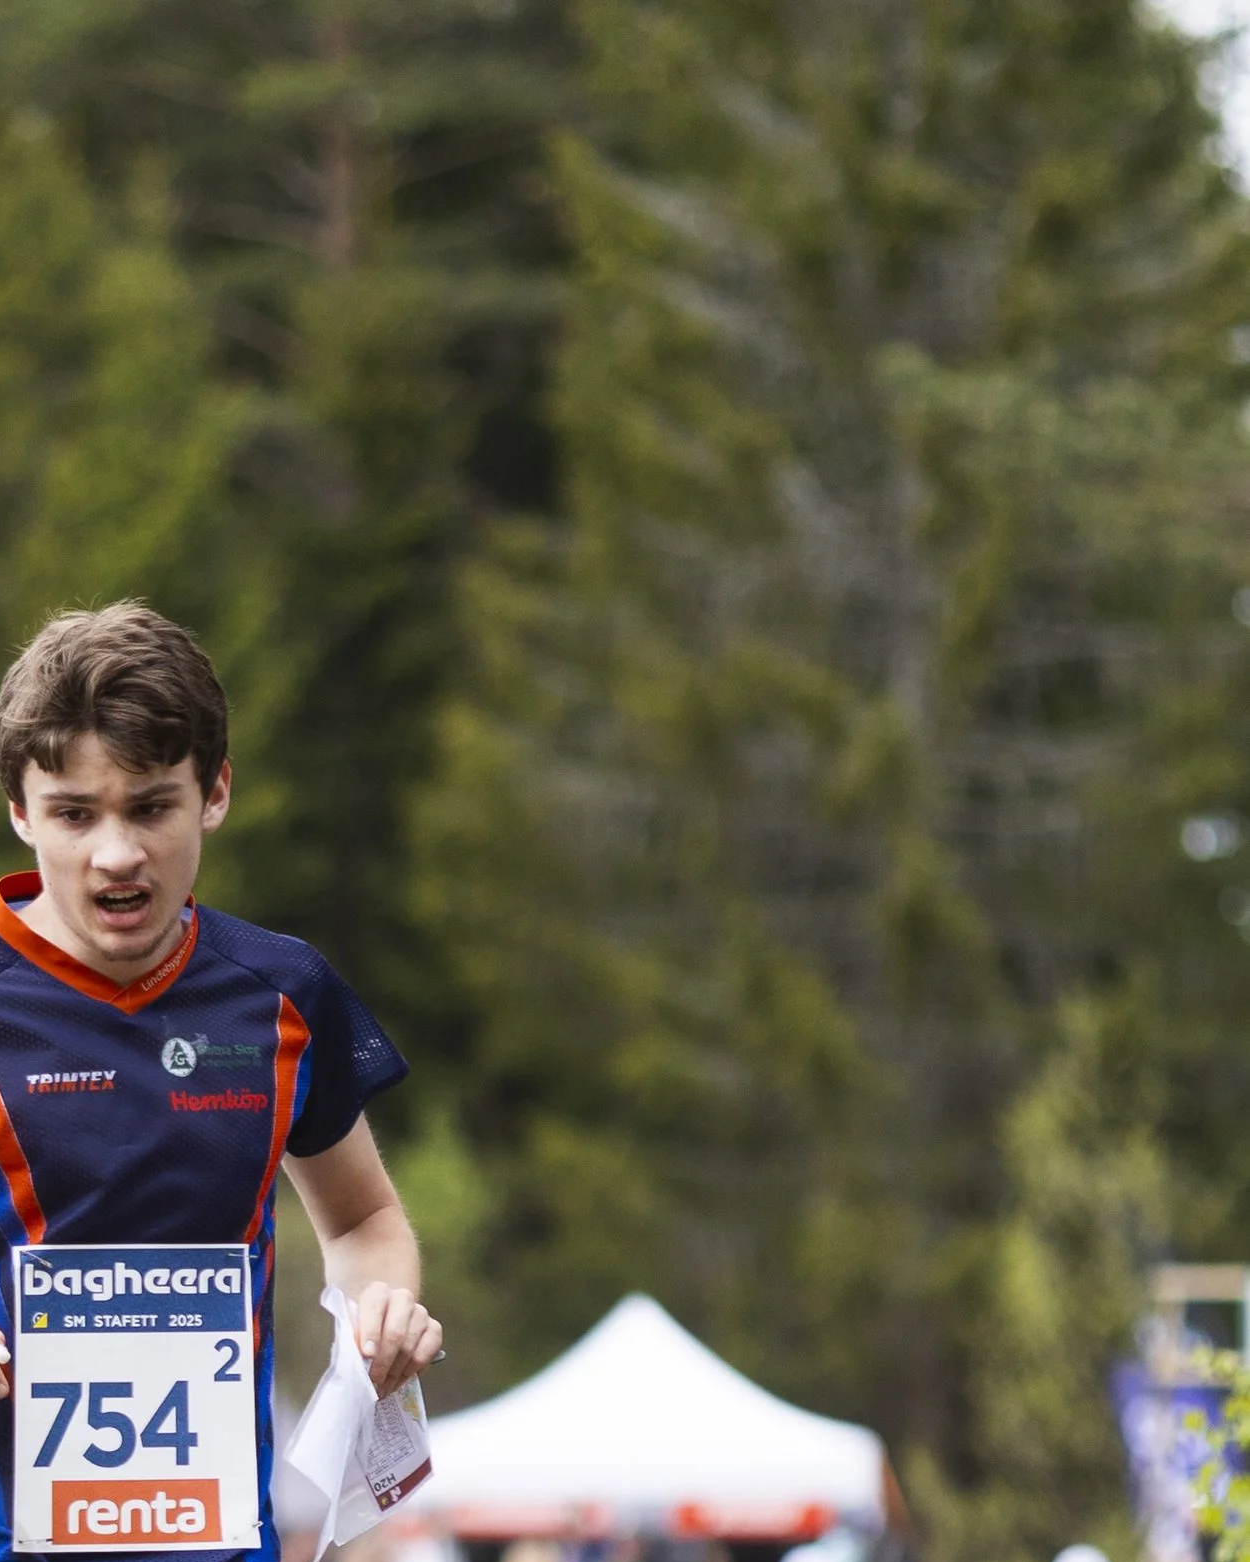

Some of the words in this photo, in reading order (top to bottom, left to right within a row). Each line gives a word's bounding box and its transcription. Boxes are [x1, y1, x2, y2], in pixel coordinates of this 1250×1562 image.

[26, 1070, 117, 1095] TRIMTEX
[169, 1087, 268, 1114] Hemköp
[24, 1261, 242, 1302] bagheera
[64, 1315, 86, 1328] SM
[94, 1314, 158, 1328] STAFETT
[169, 1314, 203, 1327] 2025
[213, 1338, 242, 1382] 2
[30, 1380, 199, 1468] 754
[66, 1490, 206, 1535] renta
